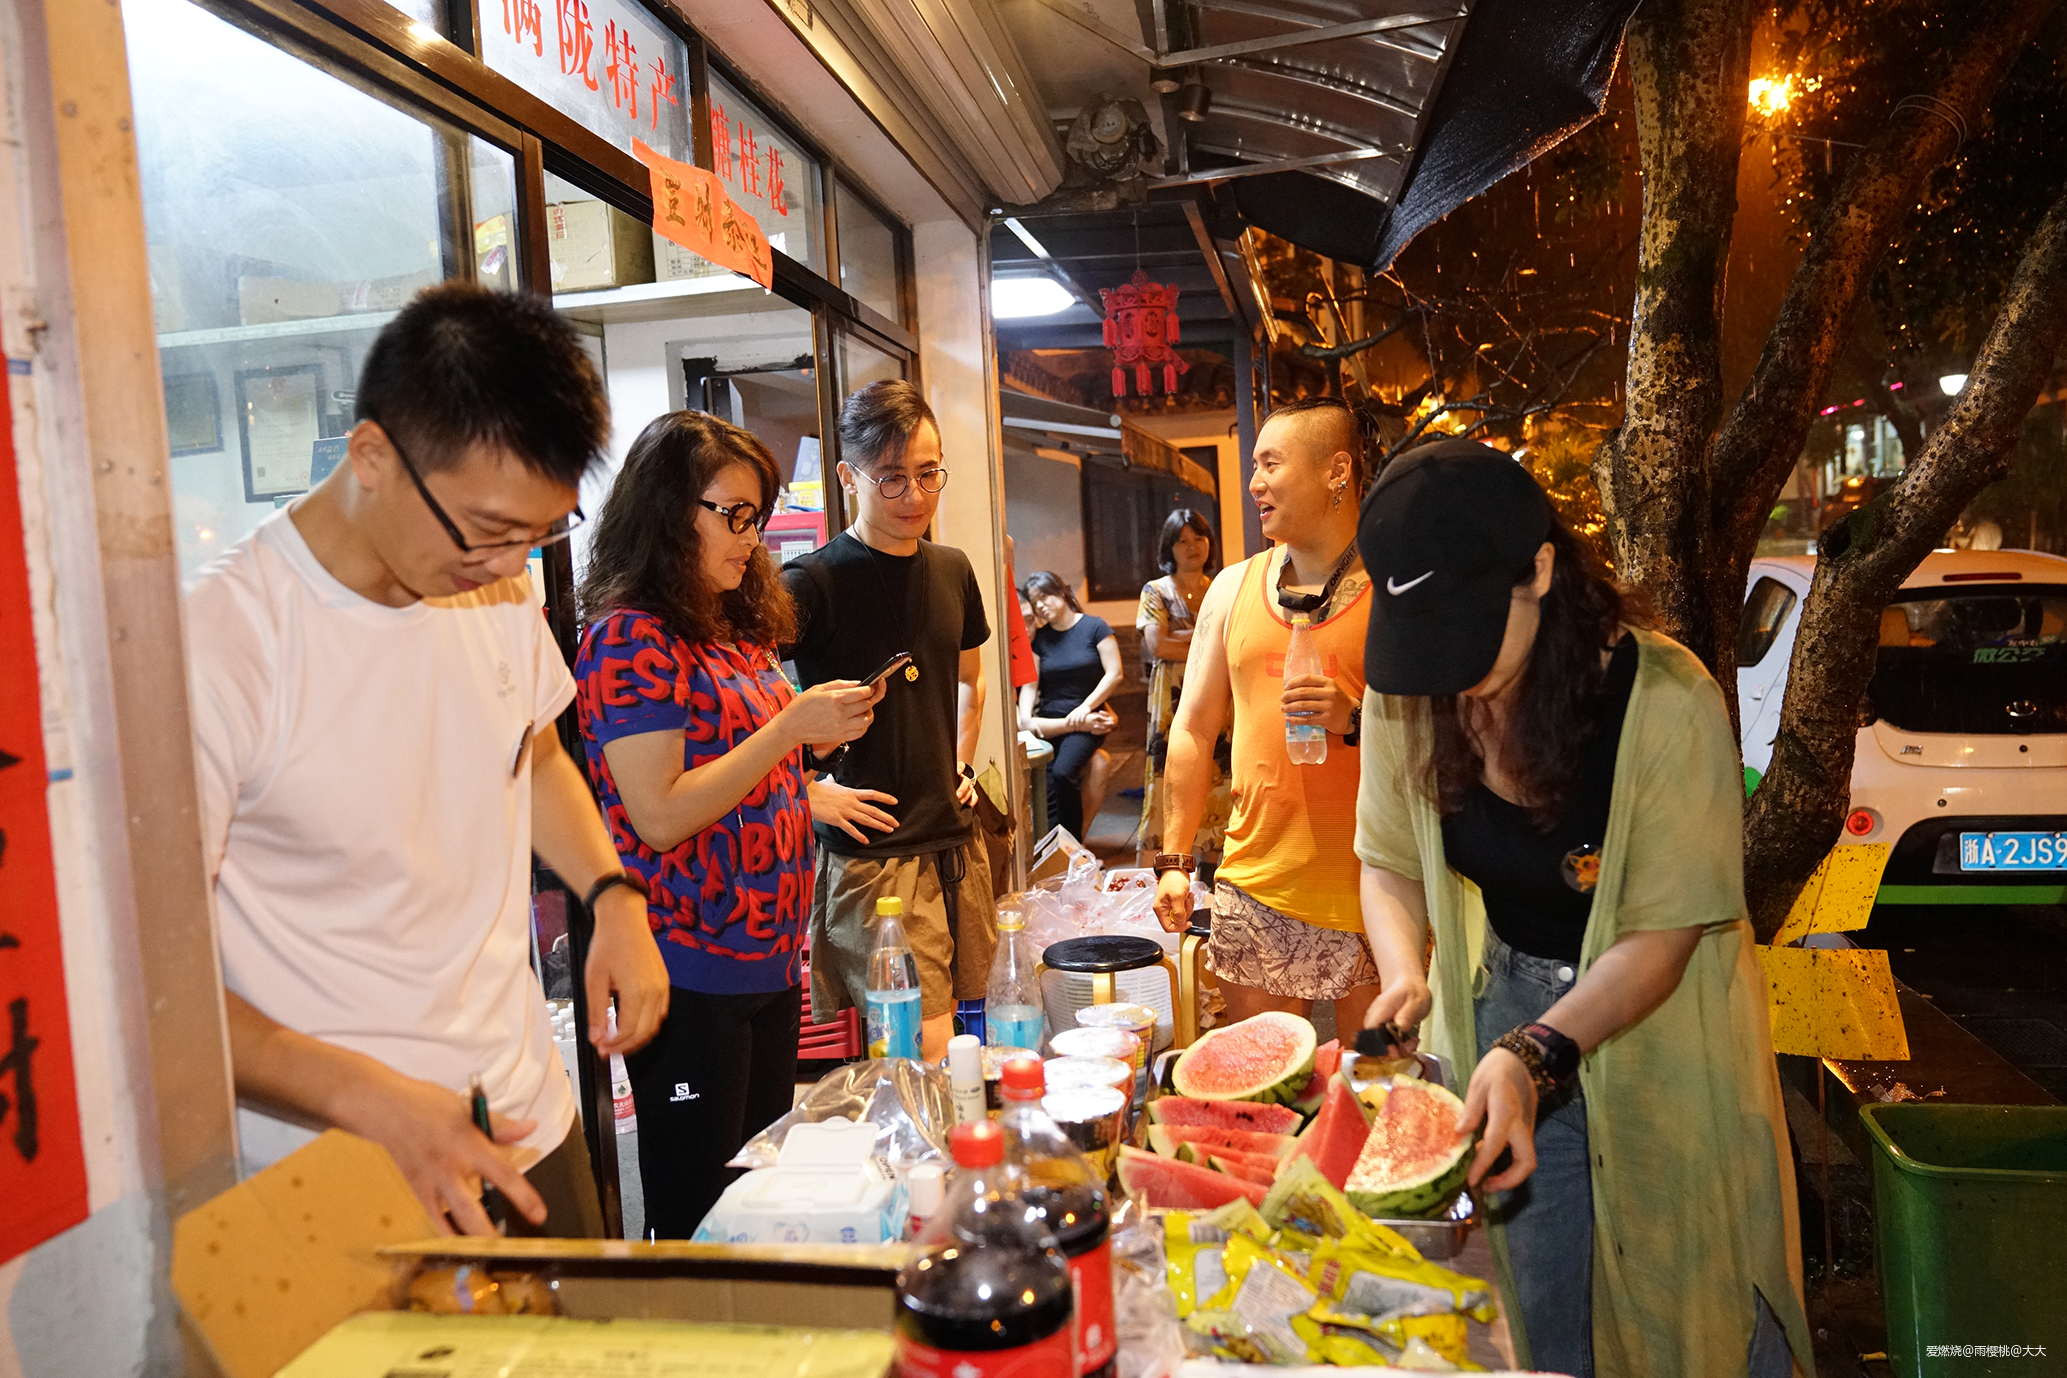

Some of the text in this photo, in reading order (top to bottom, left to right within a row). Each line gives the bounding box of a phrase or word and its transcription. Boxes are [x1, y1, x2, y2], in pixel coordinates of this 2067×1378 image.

[709, 98, 788, 217] 糖桂花
[1330, 545, 1356, 587] ONNIGHT
[669, 1093, 699, 1102] salomon
[879, 1157, 896, 1180] OPEN
